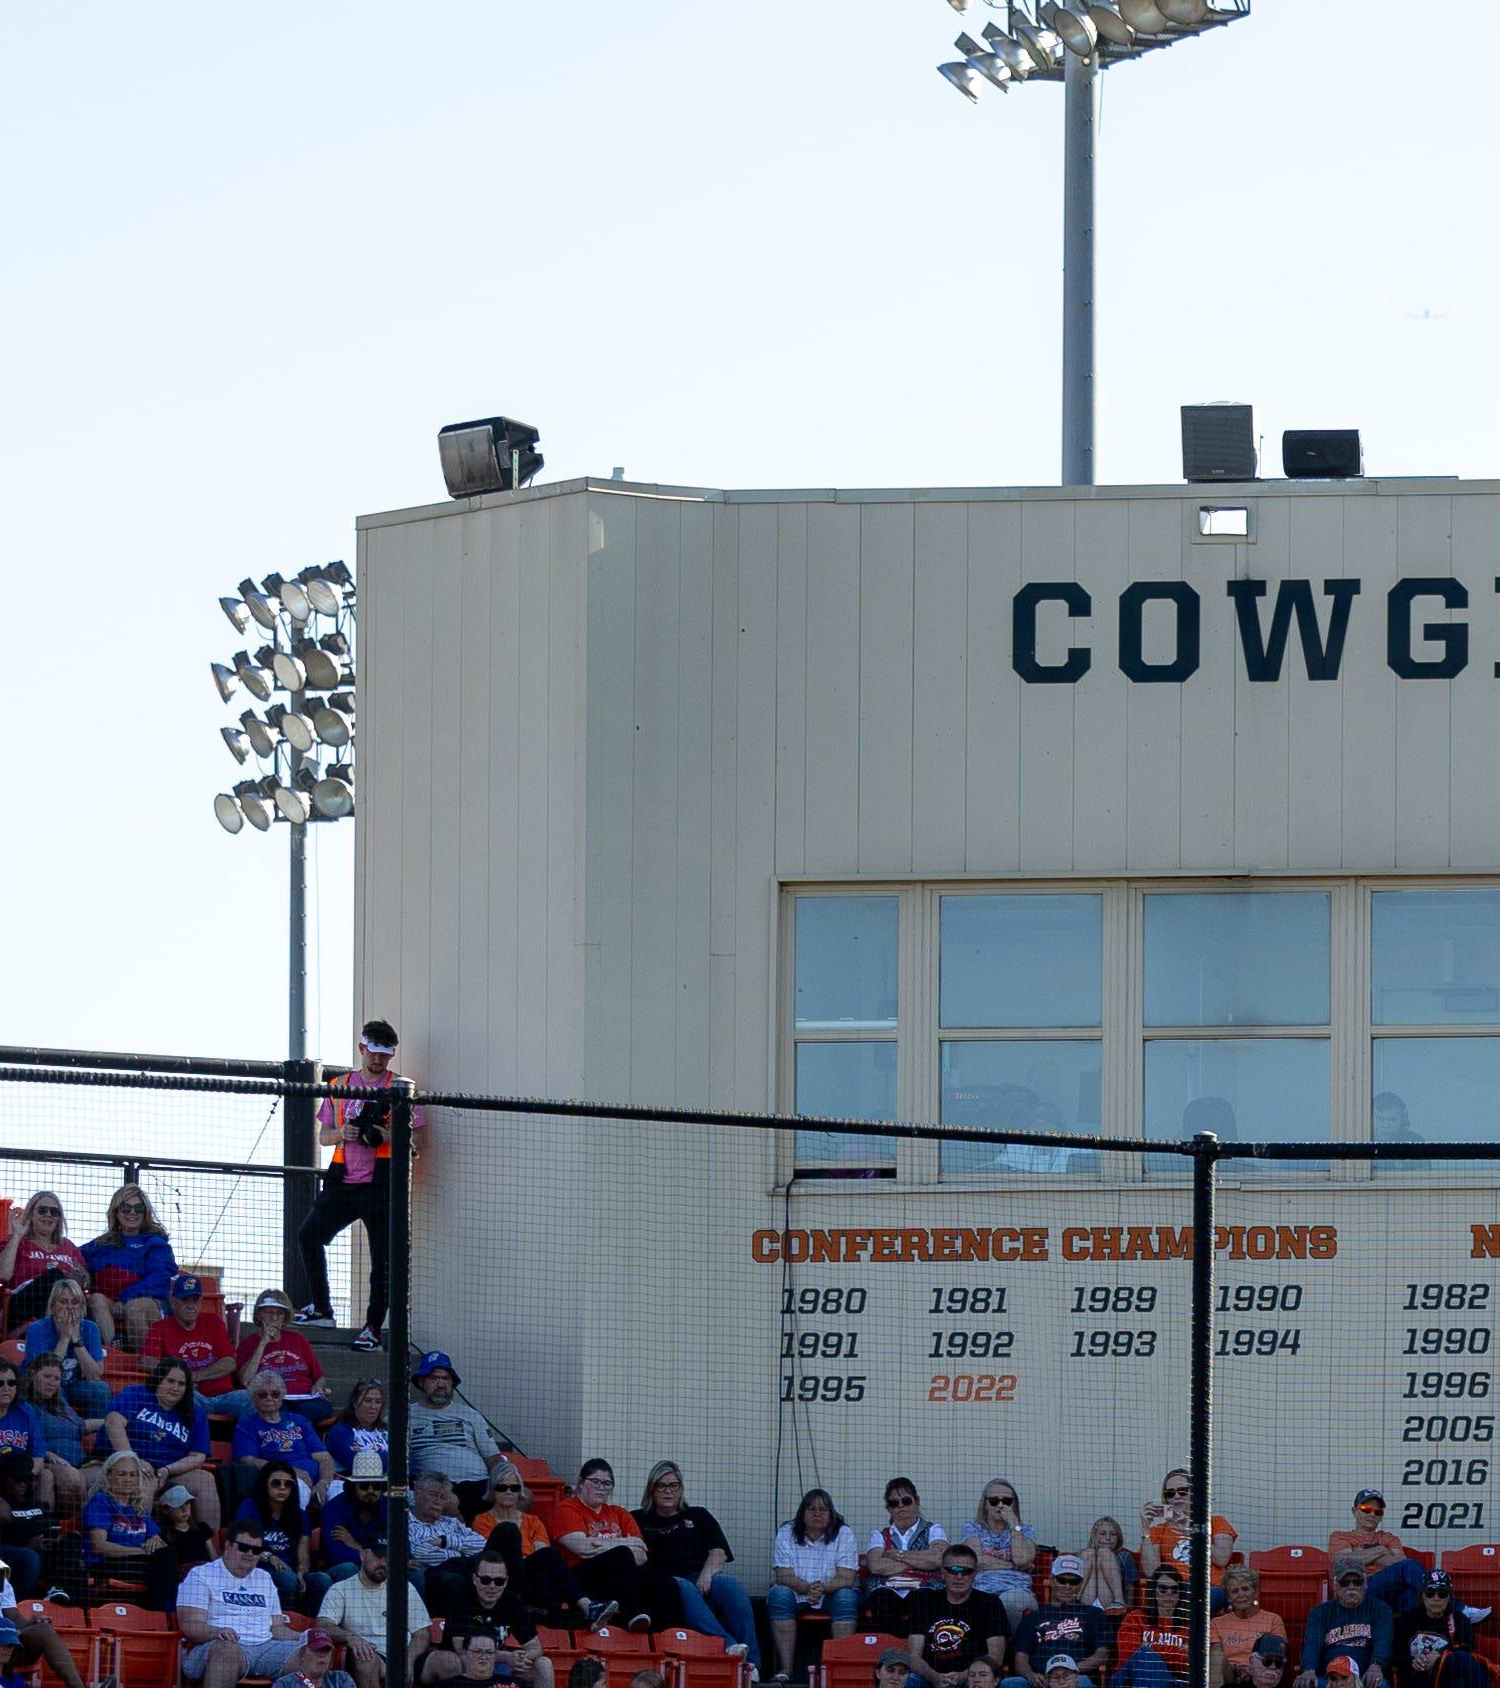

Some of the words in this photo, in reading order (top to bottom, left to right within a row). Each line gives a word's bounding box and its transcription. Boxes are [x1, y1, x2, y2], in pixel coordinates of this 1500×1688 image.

[752, 1229, 1047, 1261] CONFERENCE
[780, 1288, 866, 1316] 1980
[929, 1288, 1006, 1313] 1981
[1071, 1287, 1157, 1312] 1989
[1215, 1285, 1302, 1317] 1990
[1403, 1284, 1489, 1310] 1982
[780, 1331, 857, 1358] 1991
[929, 1332, 1014, 1357] 1992
[1071, 1331, 1157, 1357] 1993
[1215, 1329, 1300, 1359] 1994
[1403, 1328, 1490, 1354] 1990
[779, 1376, 866, 1401] 1995
[932, 1376, 1015, 1400] 2022
[1403, 1372, 1490, 1398] 1996
[137, 1408, 189, 1444] KANSAS
[1403, 1416, 1495, 1441] 2005
[1402, 1460, 1488, 1485] 2016
[1401, 1503, 1483, 1529] 2021
[223, 1591, 267, 1608] KANSAS
